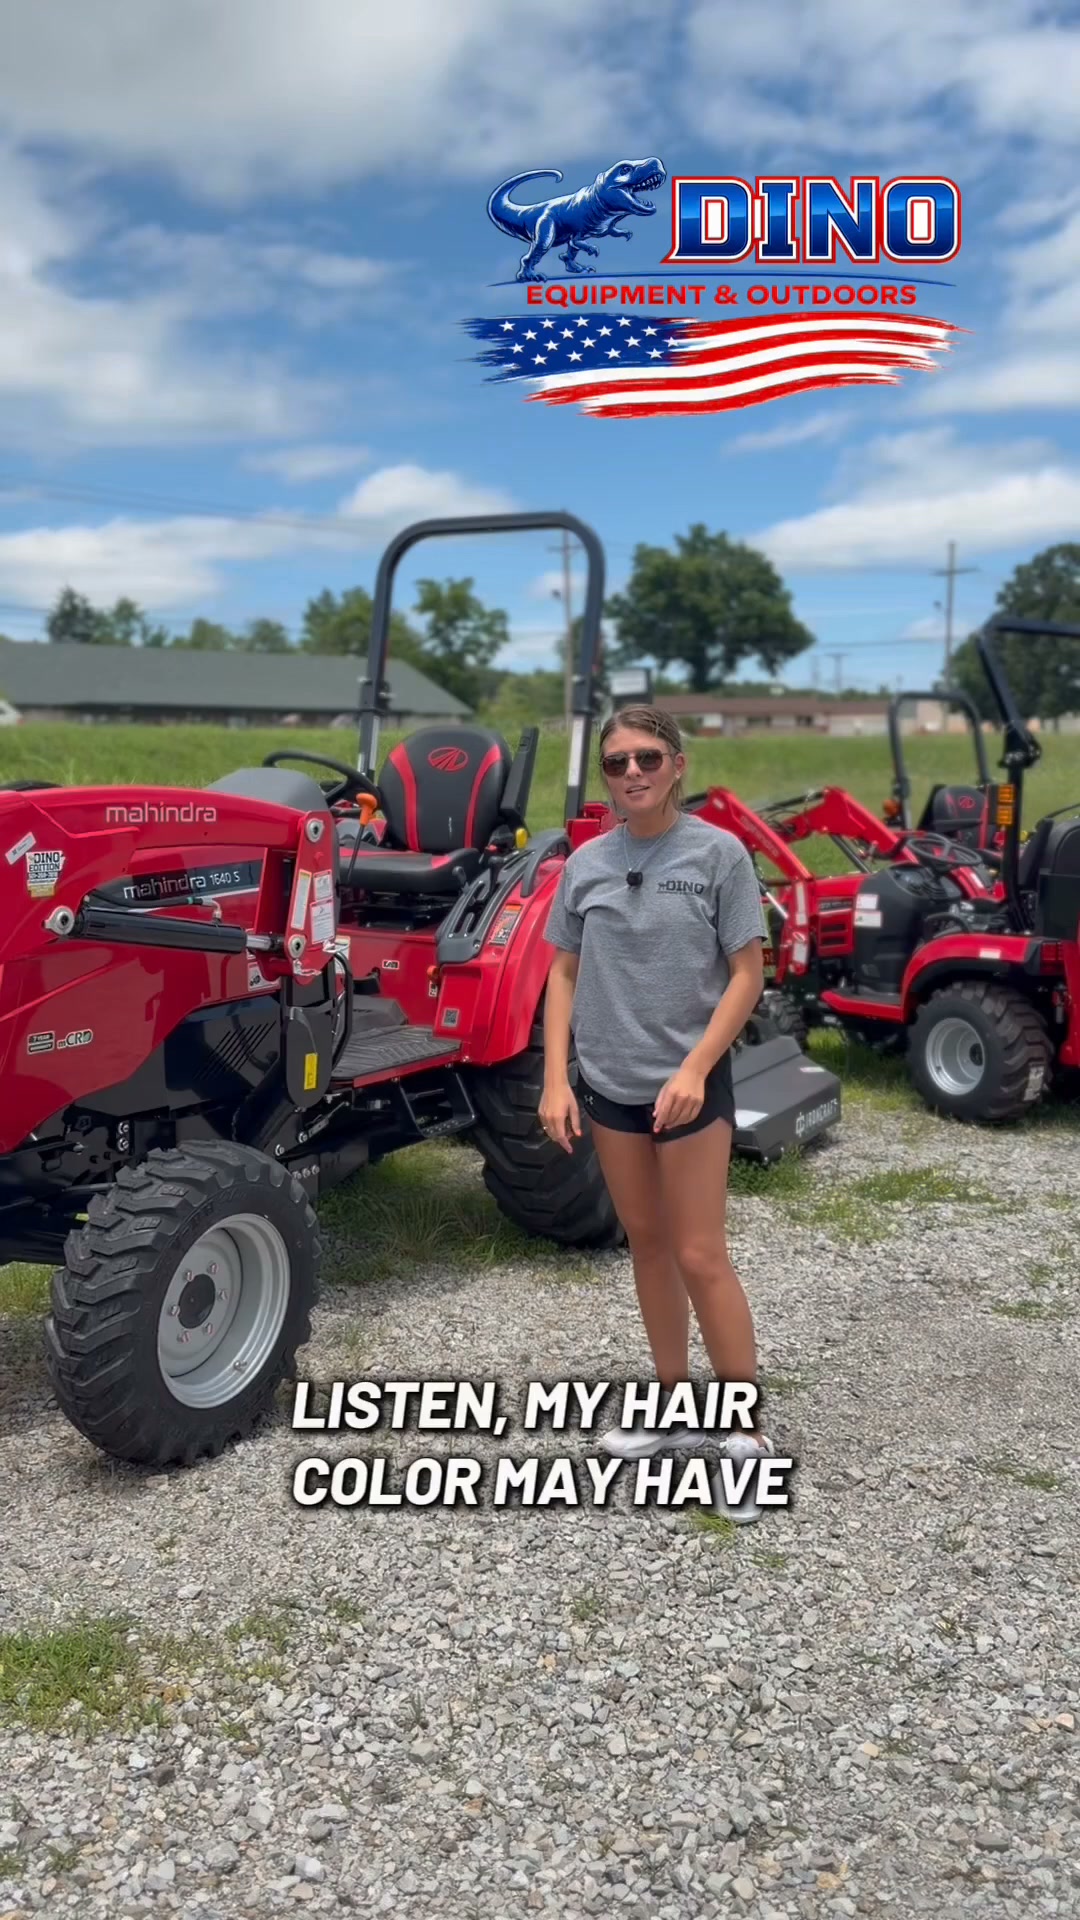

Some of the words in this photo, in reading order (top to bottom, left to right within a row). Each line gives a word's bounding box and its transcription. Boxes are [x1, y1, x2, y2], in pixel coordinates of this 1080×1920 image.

[105, 802, 217, 823] mahindra
[34, 852, 60, 864] DINO
[29, 863, 60, 872] EDITION
[123, 874, 207, 899] mahindra
[209, 872, 232, 886] 1640
[233, 871, 241, 883] S
[666, 880, 704, 894] DINO
